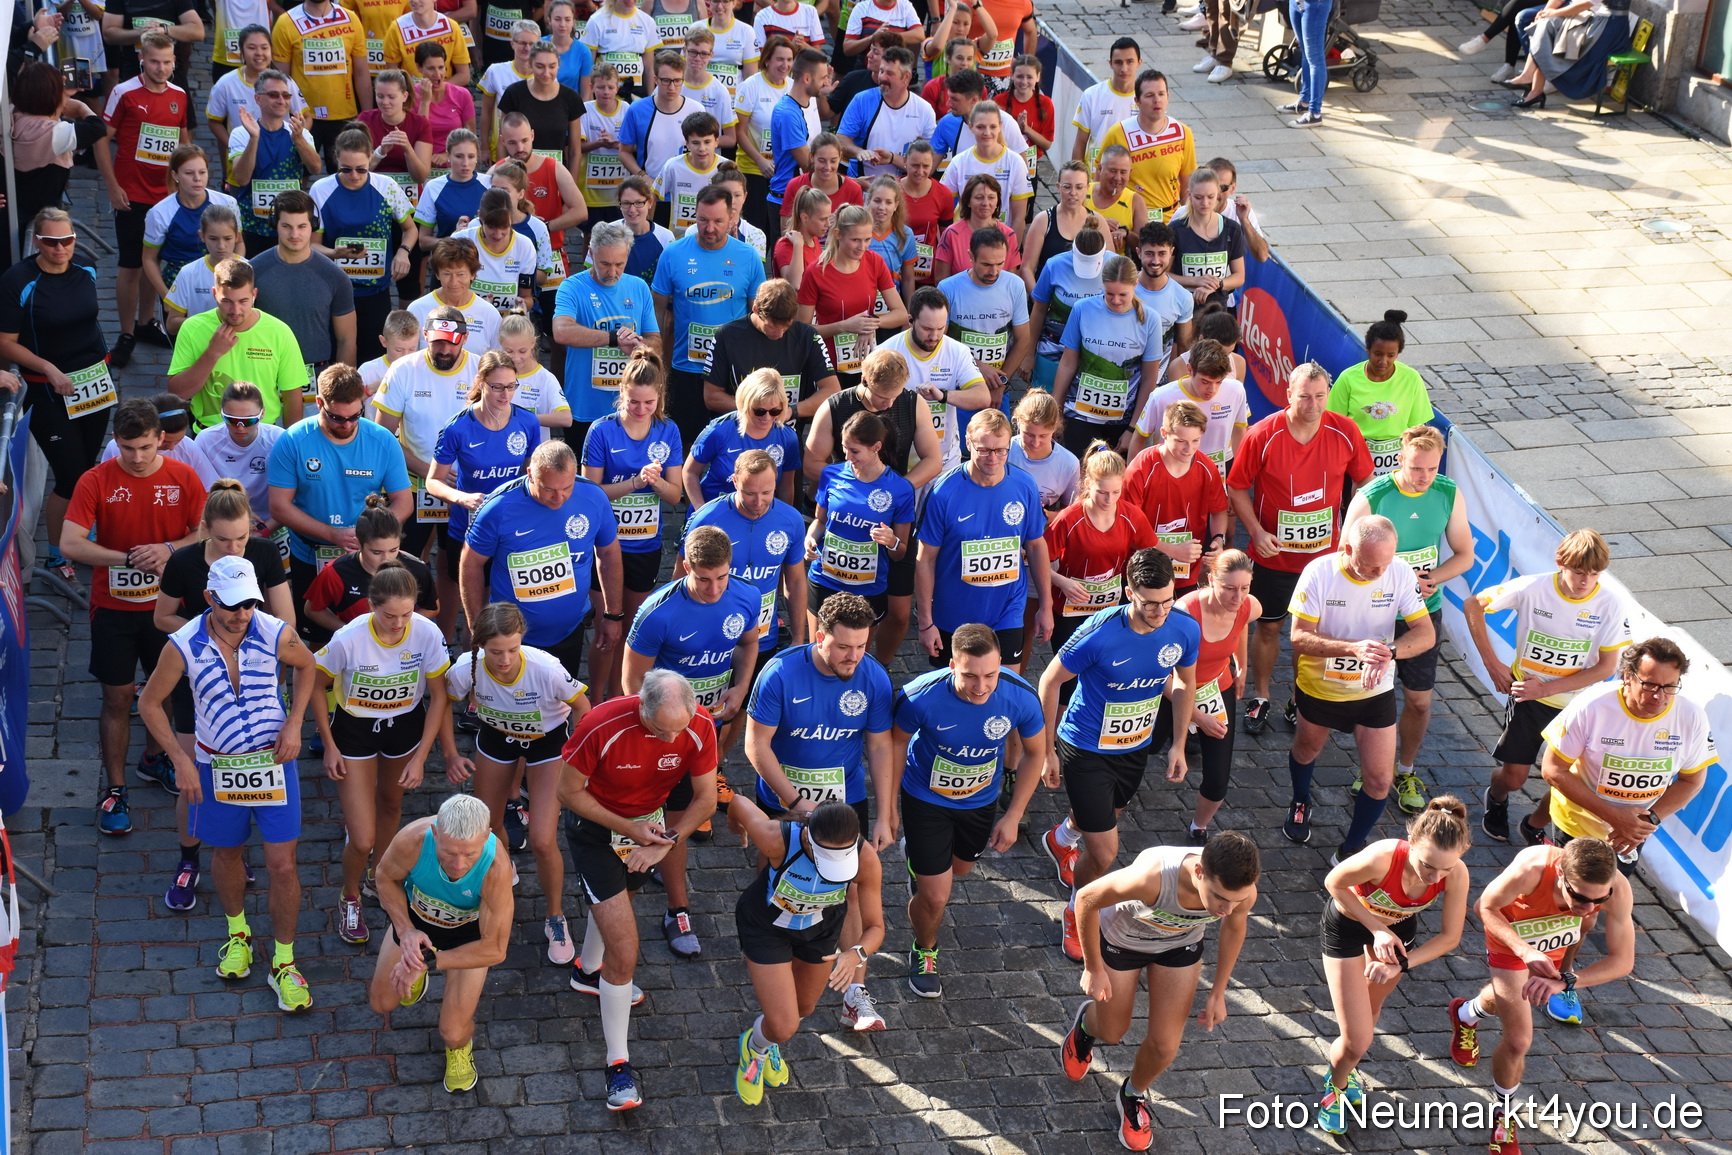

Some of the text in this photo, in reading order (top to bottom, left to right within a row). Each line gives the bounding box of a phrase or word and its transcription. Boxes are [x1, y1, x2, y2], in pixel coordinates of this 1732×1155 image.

[658, 15, 691, 26] BOCK
[329, 25, 355, 39] BÖGL
[660, 26, 689, 38] 5010
[305, 39, 339, 49] BOCK
[308, 50, 340, 63] 5101
[607, 52, 638, 62] BOCK
[144, 127, 177, 138] BOCK
[143, 137, 176, 153] 5188
[1131, 144, 1185, 164] MAX BÖGL
[591, 166, 623, 177] 5171
[256, 182, 296, 191] BOCK
[1185, 252, 1225, 264] BOCK
[1187, 265, 1223, 278] 5105
[471, 280, 512, 293] BOCK
[965, 334, 1005, 346] BOCK
[1085, 337, 1127, 349] RAIL.ONE
[71, 377, 110, 403] 5115
[1084, 377, 1124, 393] BOCK
[74, 395, 111, 413] SUSANNE
[1082, 388, 1122, 408] 5133
[1088, 407, 1110, 417] JANA
[345, 469, 373, 478] BOCK
[328, 514, 344, 525] 18.
[1282, 509, 1329, 525] BOCK
[1283, 524, 1328, 541] 5185
[827, 537, 876, 556] BOCK
[967, 538, 1015, 555] BOCK
[1287, 540, 1323, 550] HELMUT
[511, 545, 569, 566] BOCK
[826, 550, 872, 572] 5082
[968, 554, 1014, 574] 5075
[516, 561, 567, 585] 5080
[835, 570, 859, 581] ANJA
[970, 572, 1010, 585] MICHAEL
[527, 582, 561, 597] HORST
[1372, 590, 1383, 599] 20
[1577, 610, 1590, 619] 20
[1531, 633, 1586, 652] BOCK
[194, 657, 217, 665] Markus
[401, 651, 411, 660] 20
[1529, 645, 1579, 667] 5251
[357, 672, 413, 687] BOCK
[355, 686, 410, 701] 5003
[514, 690, 526, 698] 20
[357, 701, 403, 710] LUCIANA
[1109, 699, 1158, 718] BOCK
[478, 706, 537, 721] BOCK
[485, 715, 538, 734] 5164
[1109, 712, 1152, 734] 5078
[790, 723, 859, 743] #LÄUFT
[1116, 732, 1143, 747] KEVIN
[1655, 730, 1669, 740] 20
[216, 753, 274, 769] BOCK
[937, 759, 995, 776] BOCK
[1608, 758, 1666, 771] BOCK
[221, 769, 275, 789] 5061
[786, 767, 839, 785] BOCK
[938, 772, 989, 788] 5076
[1606, 771, 1664, 788] 5060
[227, 792, 274, 801] MARKUS
[950, 787, 974, 797] MAX
[1603, 788, 1659, 799] WOLFGANG
[781, 884, 842, 902] BOCK
[1519, 917, 1576, 937] BOCK
